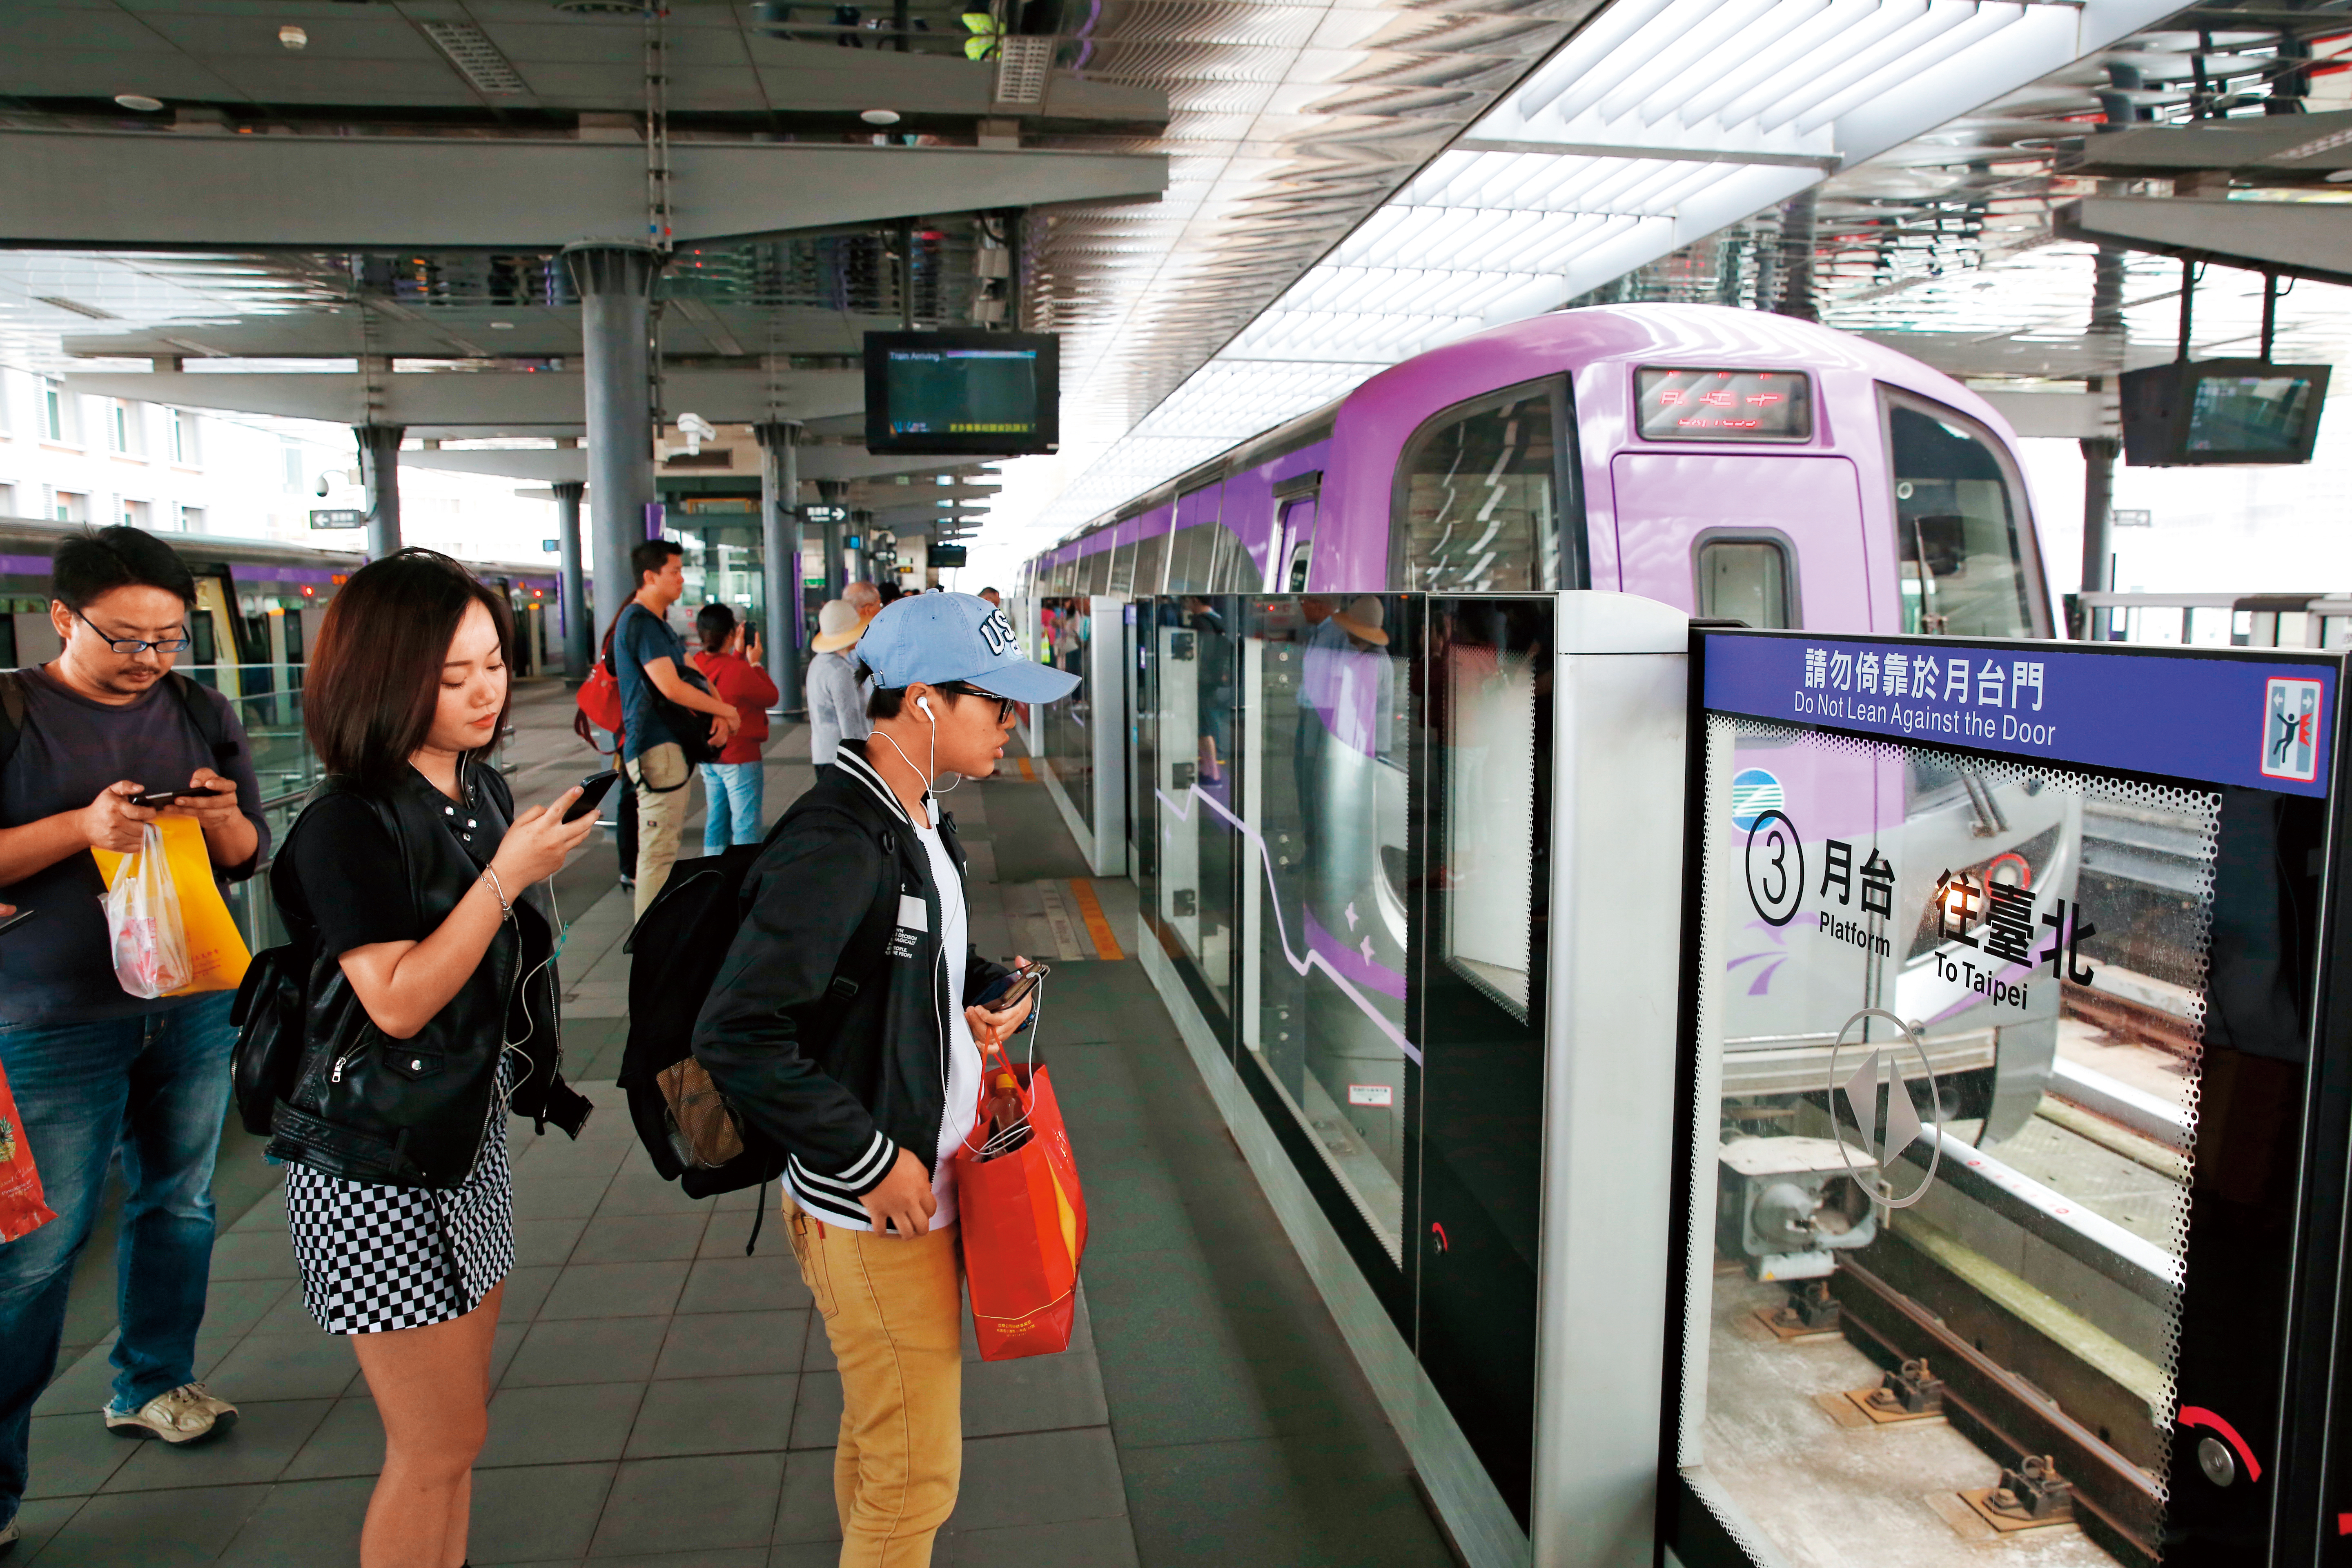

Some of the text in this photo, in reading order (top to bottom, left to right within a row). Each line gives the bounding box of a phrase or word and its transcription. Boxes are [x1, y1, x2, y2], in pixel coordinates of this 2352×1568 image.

[979, 609, 1016, 656] US
[1805, 648, 2044, 711] 請勿倚靠於月台門
[1795, 690, 2056, 746] Do Not Lean Against the Door
[1820, 838, 1896, 921] 月台
[1820, 911, 1890, 958] Platform
[1935, 867, 2097, 987] 往臺北
[1934, 951, 2028, 1010] To Taipei
